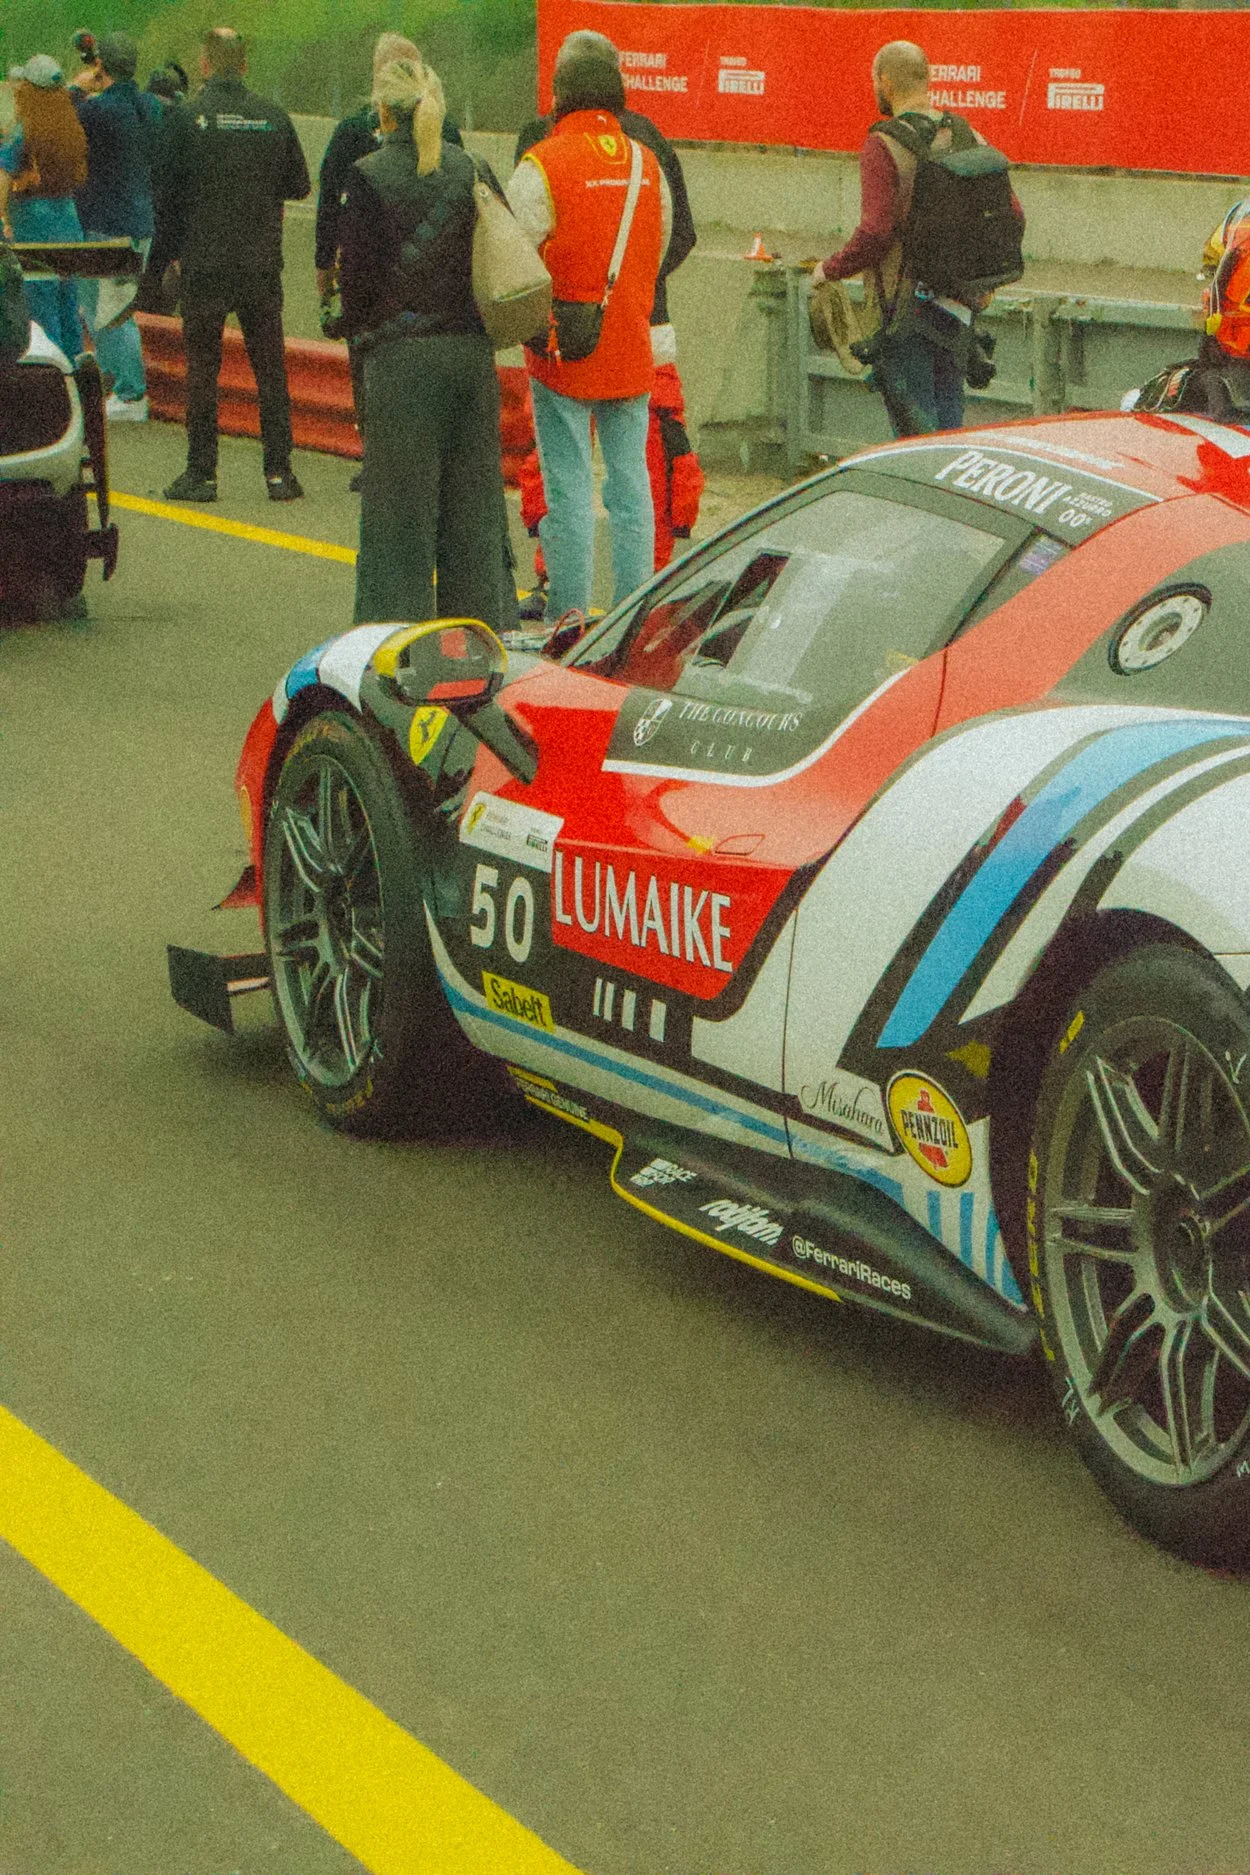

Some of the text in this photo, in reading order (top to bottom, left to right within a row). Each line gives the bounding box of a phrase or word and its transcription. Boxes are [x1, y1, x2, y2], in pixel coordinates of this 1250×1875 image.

[718, 69, 766, 95] PIRELLI
[928, 90, 1006, 109] HALLENGE
[1048, 83, 1105, 110] PIRELLI
[935, 451, 1072, 515] PERONI
[470, 864, 534, 963] 50
[554, 849, 733, 974] LUMAIKE
[490, 978, 547, 1028] Sabelt
[800, 1080, 884, 1136] Misahara
[901, 1109, 959, 1150] PENNZOIL
[792, 1235, 912, 1300] @FerrariRaces
